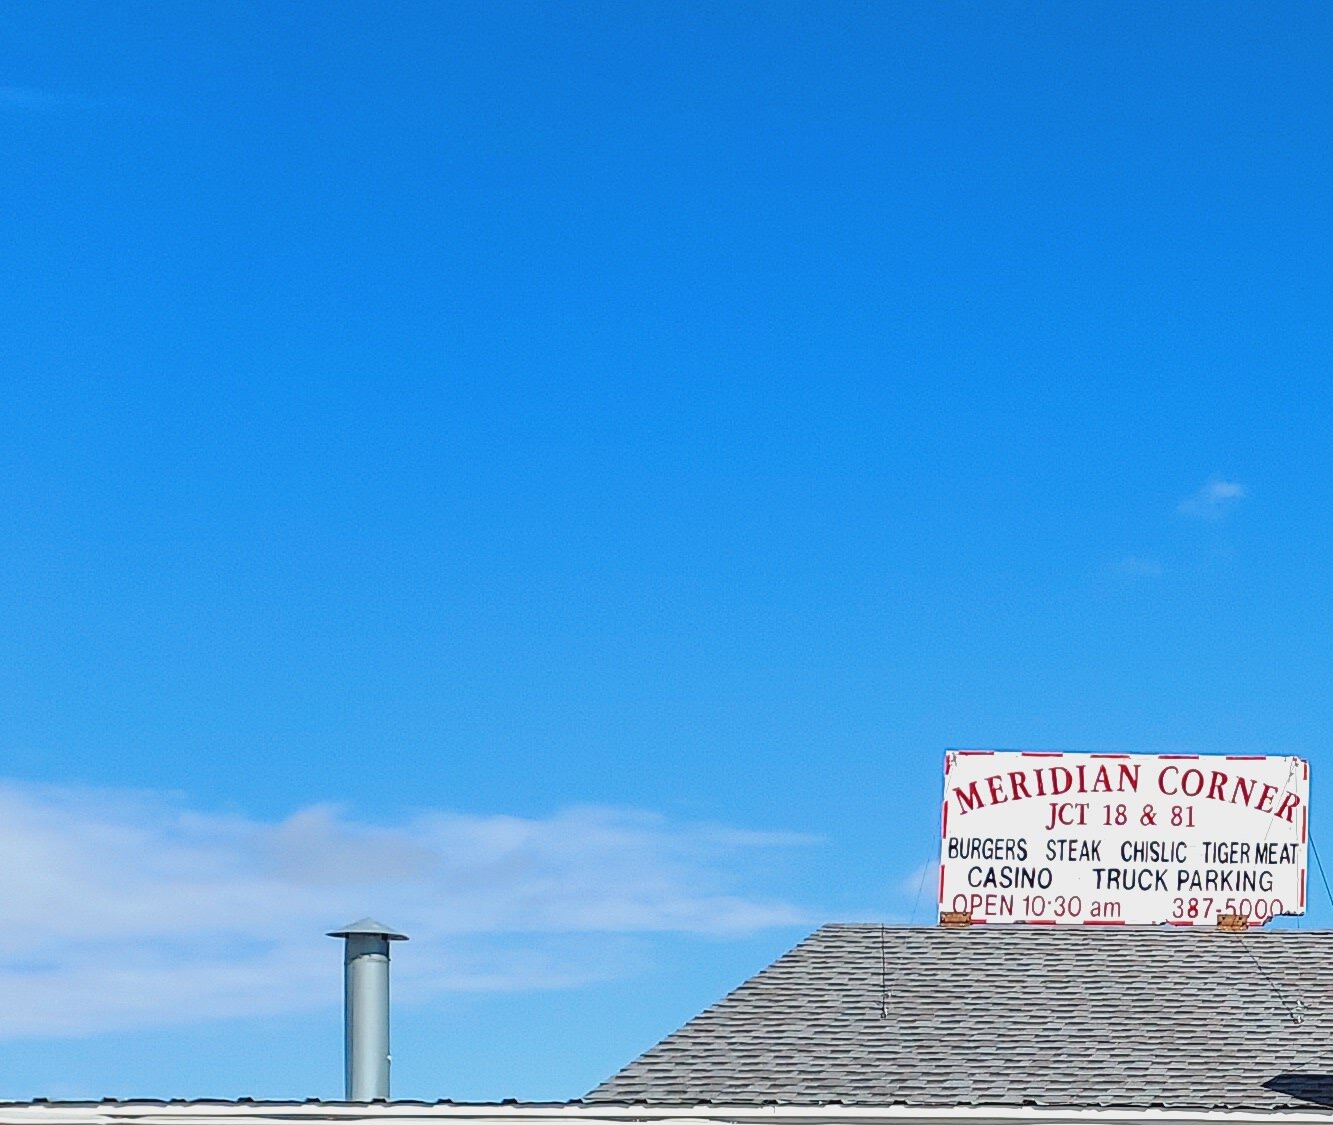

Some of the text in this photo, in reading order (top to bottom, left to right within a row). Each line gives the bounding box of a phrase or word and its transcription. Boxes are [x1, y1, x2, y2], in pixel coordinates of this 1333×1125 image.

[952, 763, 1301, 824] MERIDIAN CORNER
[1045, 802, 1196, 831] JCT 18 & 81
[948, 837, 1299, 865] BURGERS STEAK CHISLIC TIGER MEAT
[967, 866, 1274, 892] CASINO TRUCK PARKING
[952, 893, 1014, 917] OPEN
[1090, 900, 1121, 917] am
